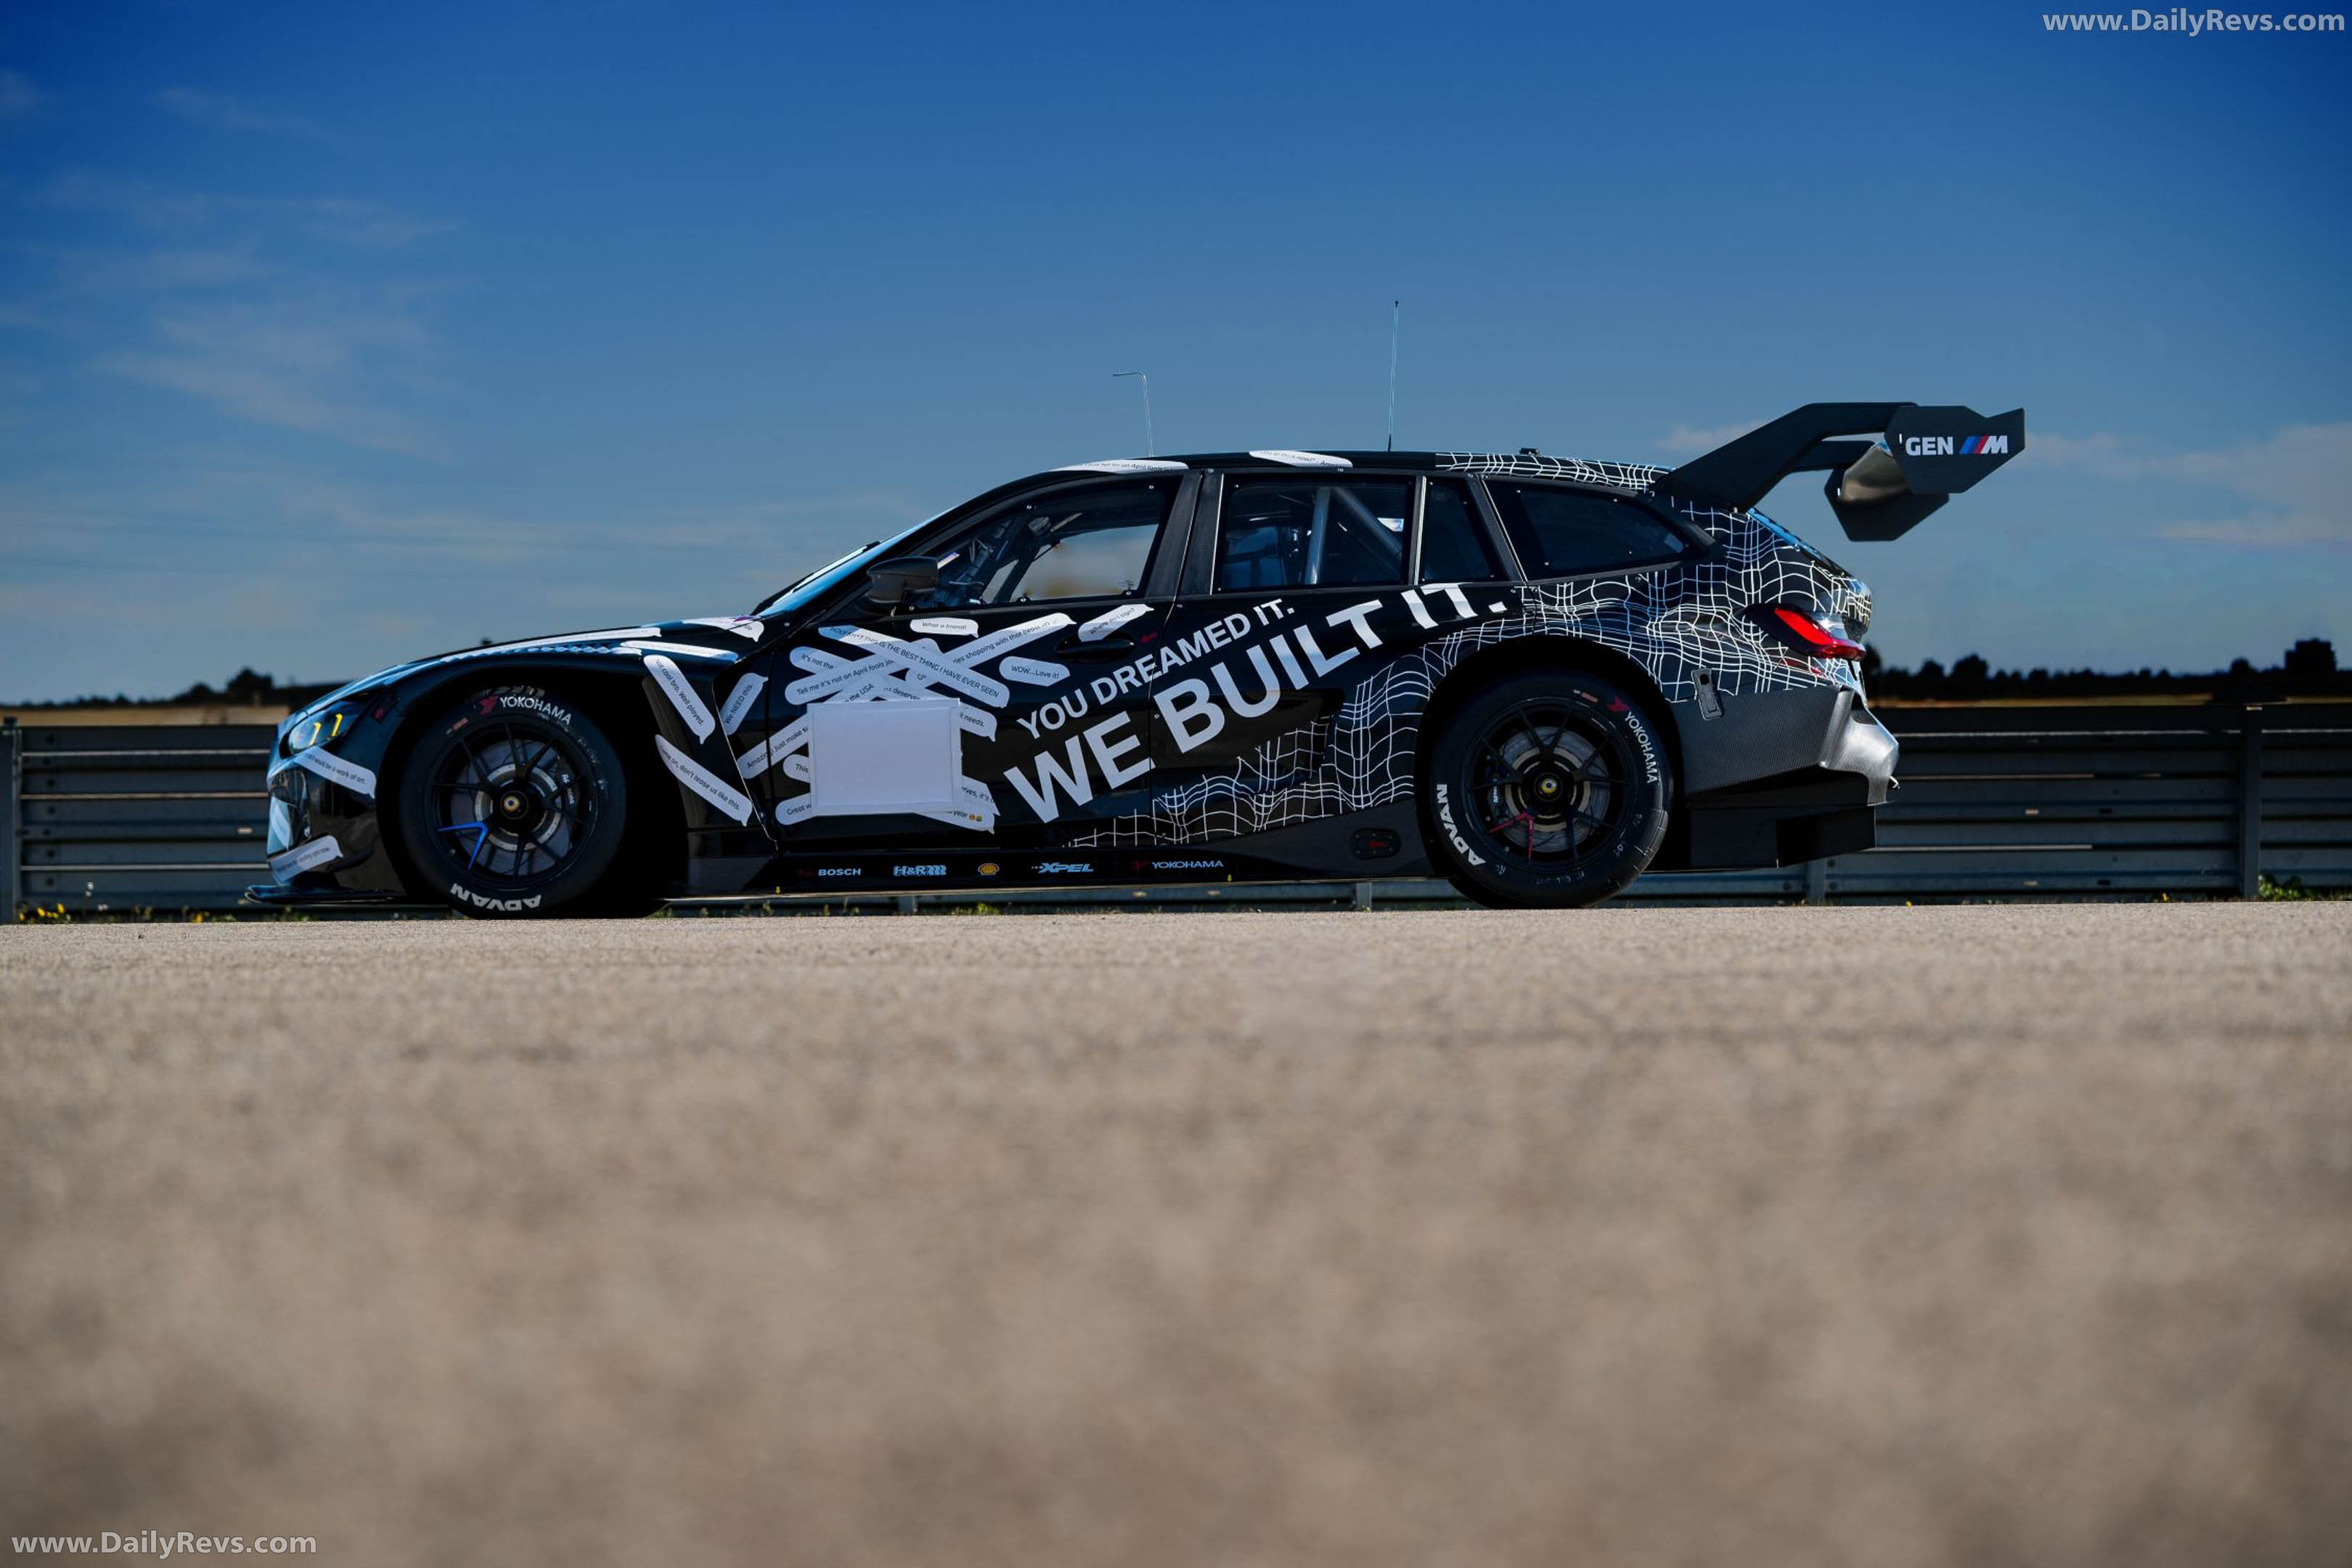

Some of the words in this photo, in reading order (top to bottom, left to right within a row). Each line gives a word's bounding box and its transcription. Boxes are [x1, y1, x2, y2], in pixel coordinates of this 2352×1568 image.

[1905, 436, 1953, 456] GEN
[1979, 436, 2009, 454] M
[1089, 622, 1108, 634] Where
[965, 642, 995, 658] shopping
[995, 635, 1010, 647] with
[1009, 632, 1022, 641] that
[812, 658, 823, 666] not
[823, 661, 834, 669] the
[831, 675, 843, 684] not
[853, 666, 868, 678] April
[868, 661, 885, 671] fools
[863, 636, 878, 645] THIS
[886, 643, 901, 654] THE
[901, 649, 919, 661] BEST
[919, 657, 939, 671] THING
[944, 669, 963, 681] HAVE
[962, 677, 980, 689] EVER
[981, 685, 1000, 698] SEEN
[1017, 689, 1088, 740] YOU
[1090, 612, 1251, 705] DREAMED
[1252, 598, 1296, 626] IT.
[663, 668, 673, 682] cool
[679, 691, 690, 705] Well
[687, 703, 704, 726] played.
[725, 714, 732, 724] We
[730, 695, 745, 714] NEED
[742, 683, 754, 699] this.
[849, 693, 861, 702] the
[860, 684, 874, 695] USA
[1003, 711, 1156, 823] WE
[1153, 599, 1382, 754] BUILT
[1402, 582, 1506, 629] IT.
[500, 696, 572, 725] YOKOHAMA
[964, 715, 985, 727] needs.
[774, 741, 786, 752] Just
[785, 732, 802, 744] make
[1625, 711, 1657, 784] YOKOHAMA
[796, 763, 809, 773] This
[679, 765, 694, 778] don't
[694, 775, 711, 789] tease
[710, 786, 717, 795] us
[717, 791, 728, 801] like
[728, 798, 740, 811] this.
[787, 806, 805, 815] Great
[1436, 784, 1486, 866] ADVAN
[1038, 862, 1093, 873] XPEL
[1152, 860, 1224, 869] YOKOHAMA
[450, 883, 542, 912] ADVAN
